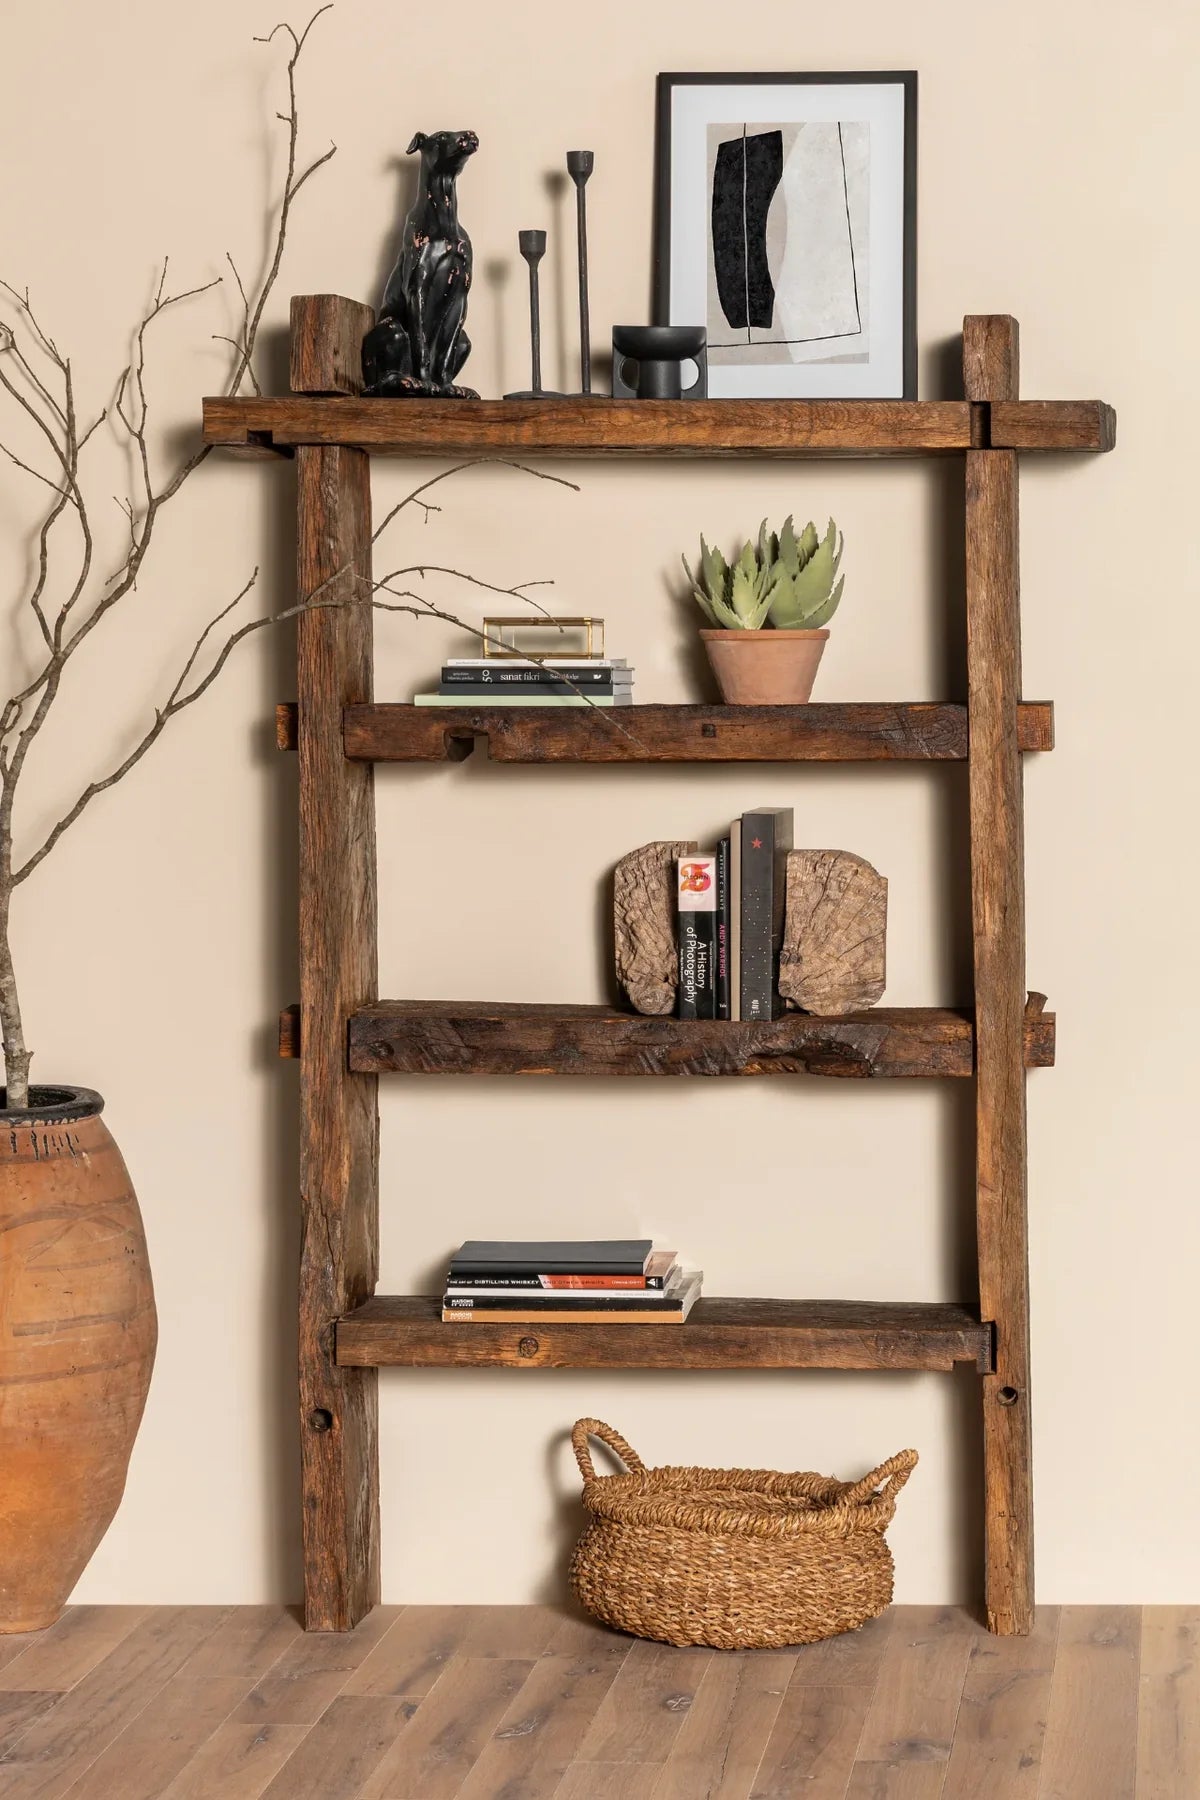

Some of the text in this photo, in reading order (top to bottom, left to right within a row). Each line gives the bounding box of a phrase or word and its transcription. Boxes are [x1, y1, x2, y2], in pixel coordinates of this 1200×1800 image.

[500, 671, 540, 681] sanat fikri
[684, 926, 698, 1004] of Photography
[695, 941, 707, 989] A History
